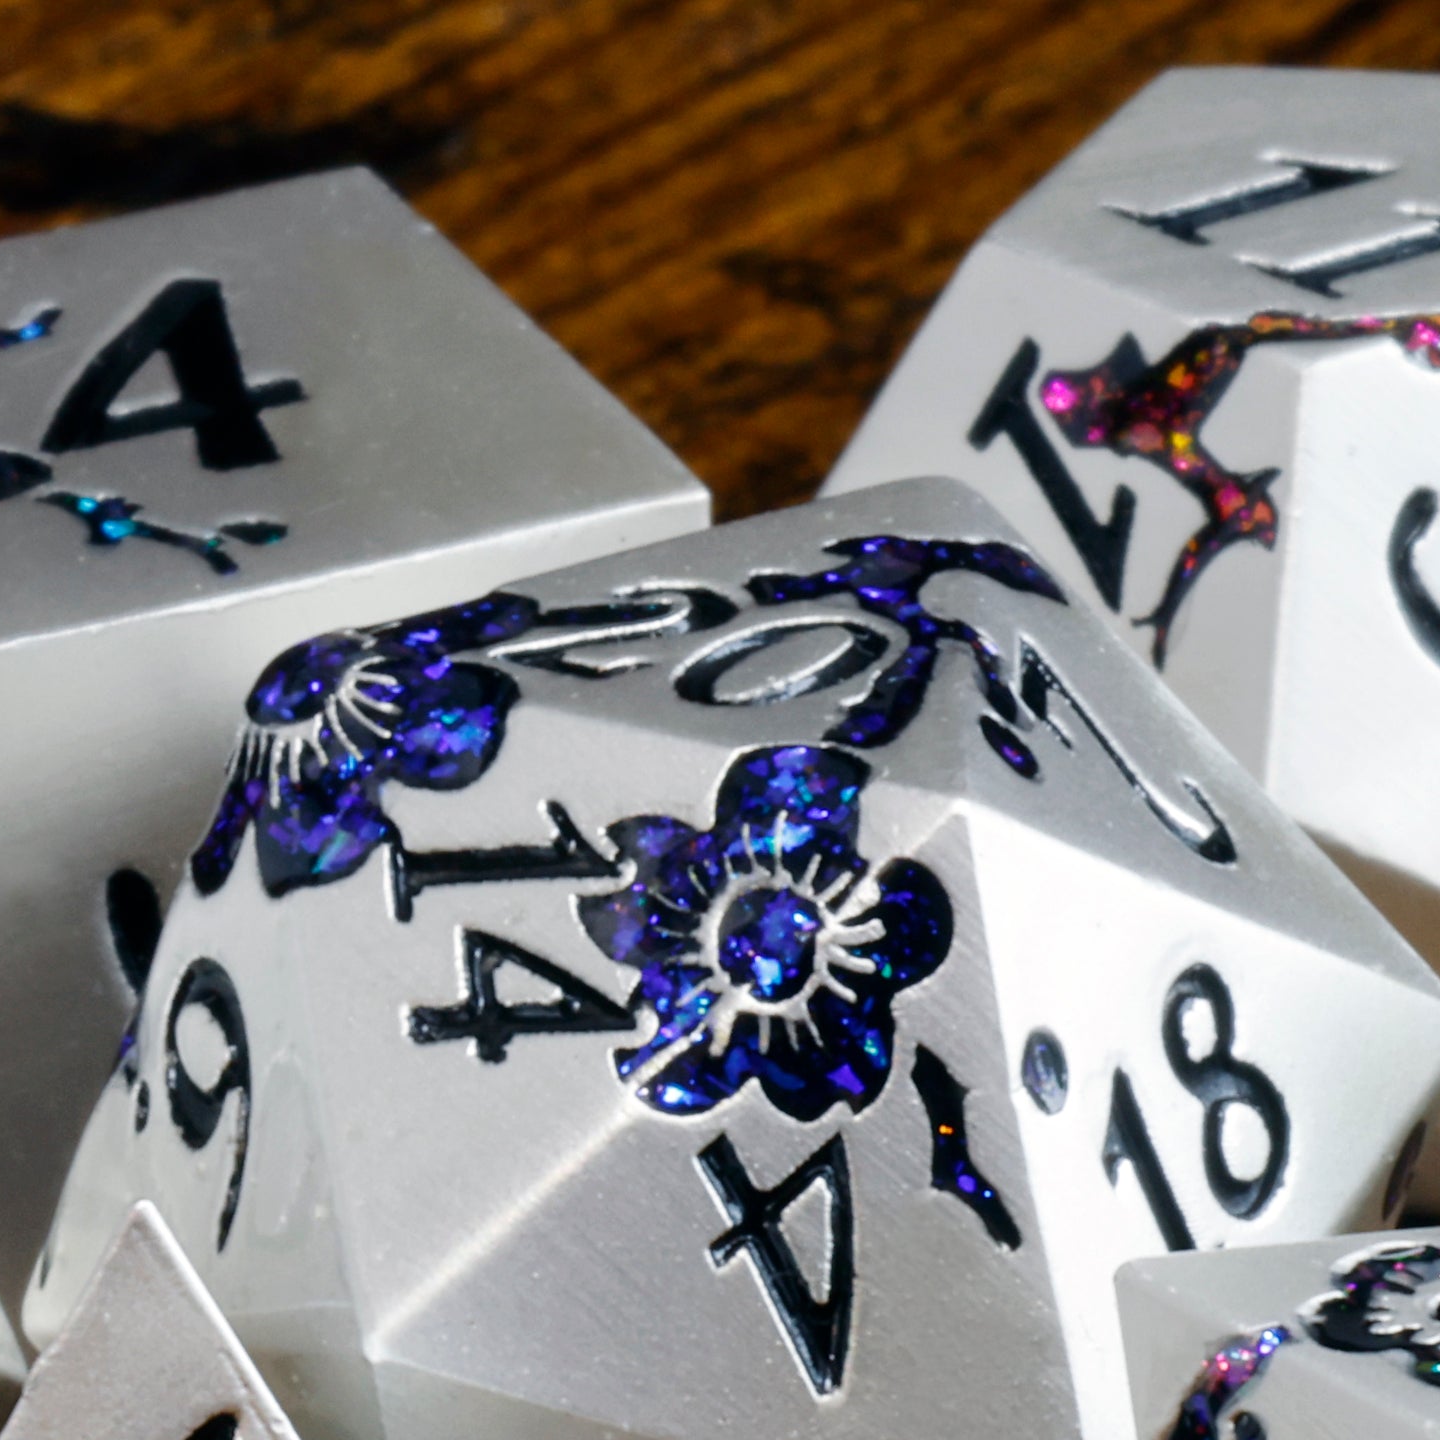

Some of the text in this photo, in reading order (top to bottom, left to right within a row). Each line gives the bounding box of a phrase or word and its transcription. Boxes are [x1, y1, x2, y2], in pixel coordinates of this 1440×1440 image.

[41, 277, 308, 471] 4
[488, 580, 891, 706] 20
[384, 800, 640, 1064] 14
[1101, 962, 1290, 1252] 18
[694, 1132, 854, 1402] 4
